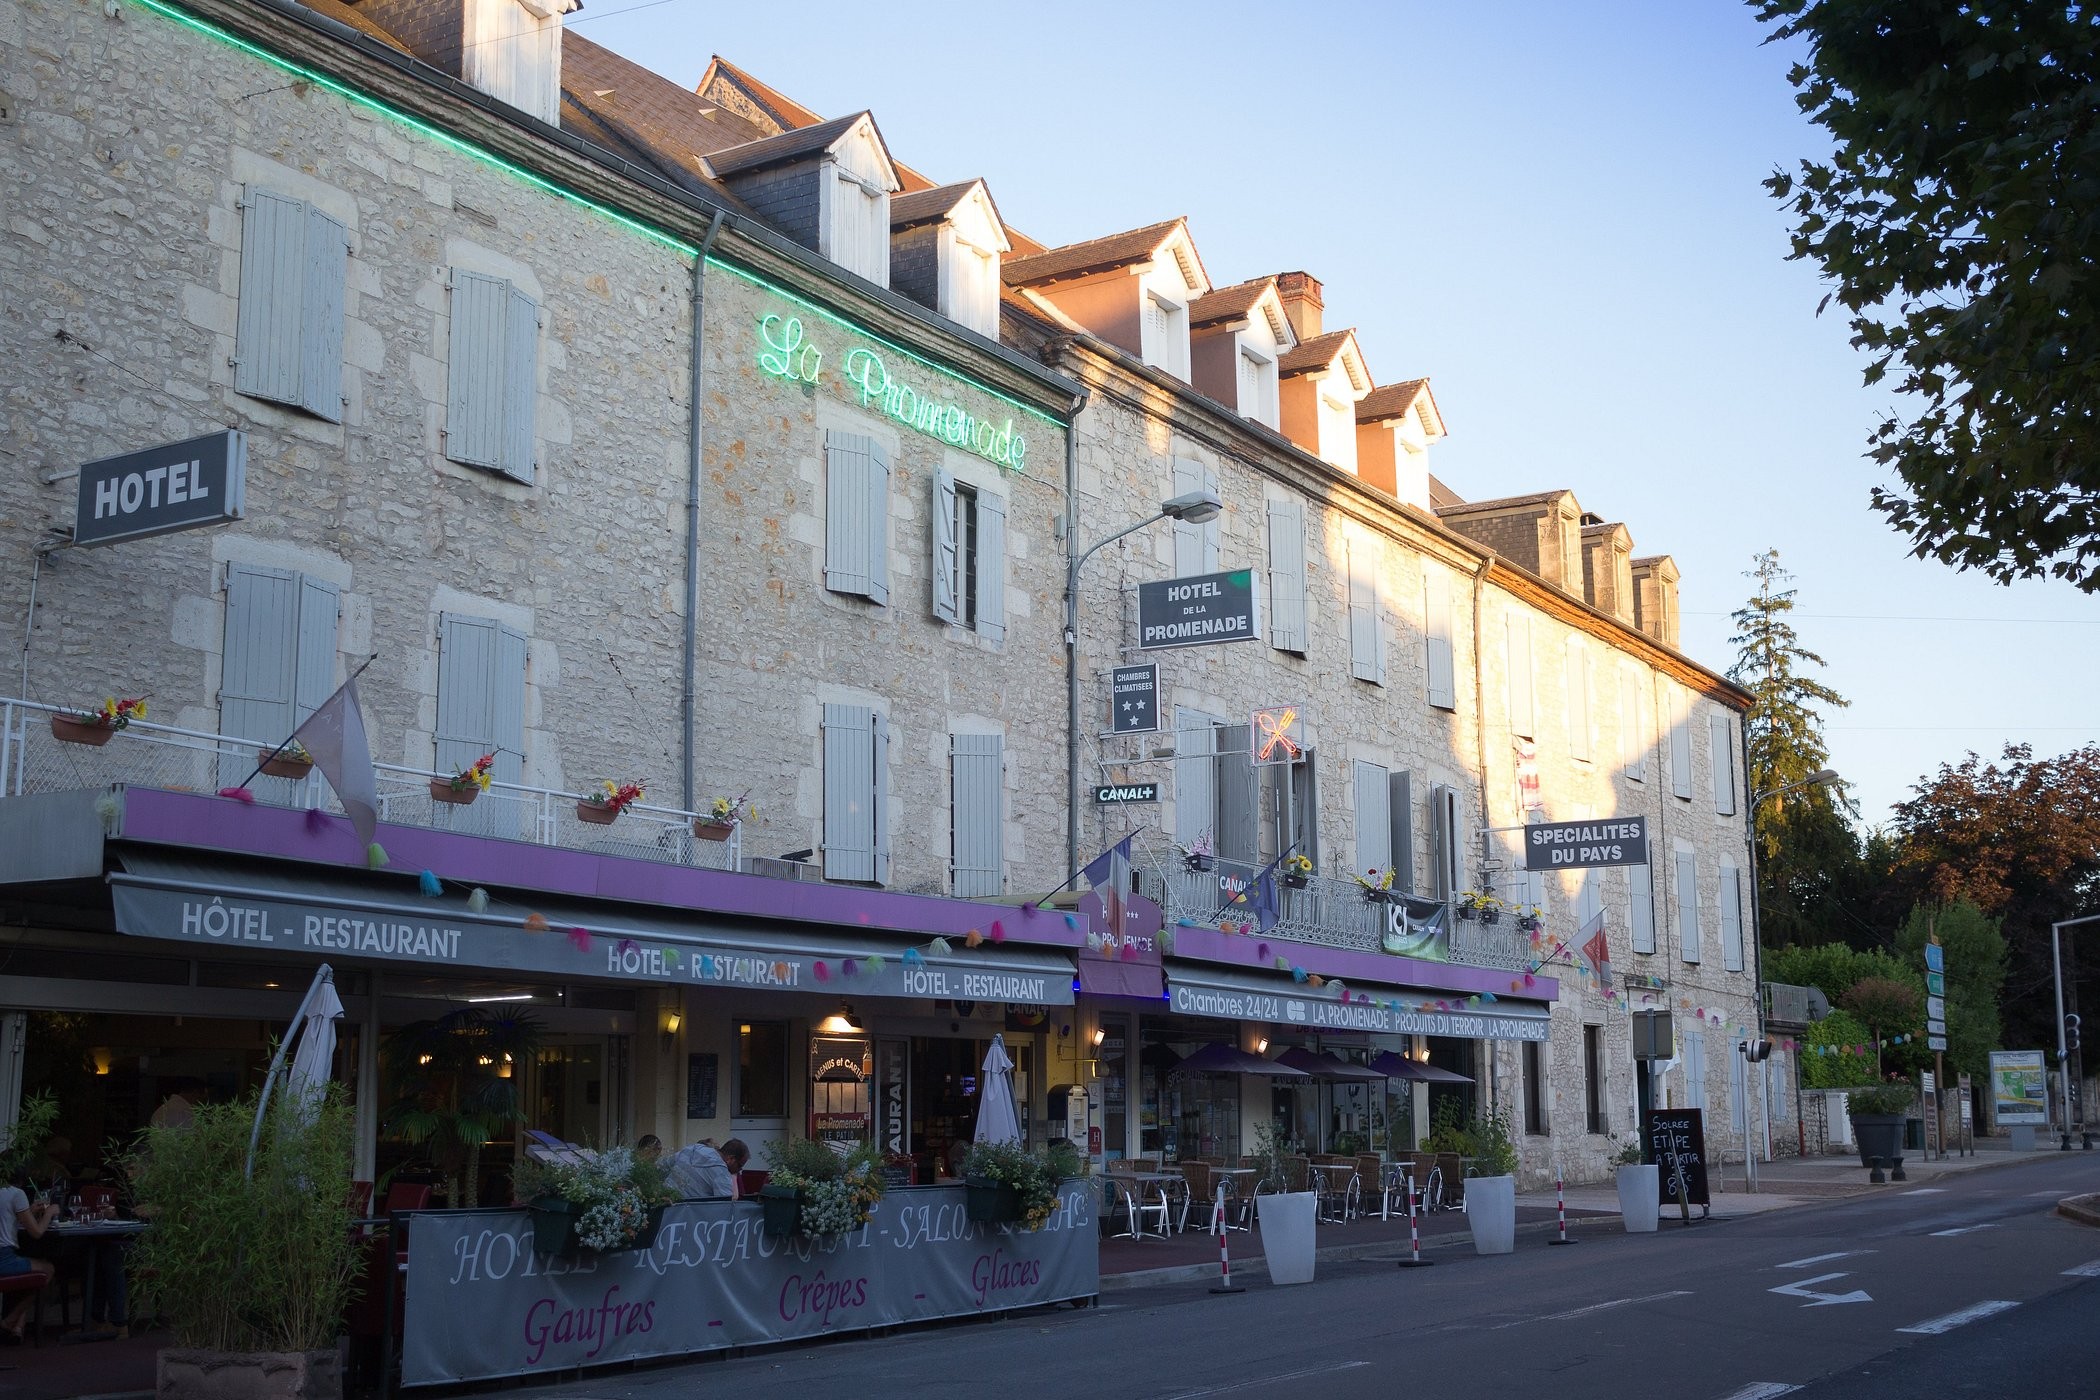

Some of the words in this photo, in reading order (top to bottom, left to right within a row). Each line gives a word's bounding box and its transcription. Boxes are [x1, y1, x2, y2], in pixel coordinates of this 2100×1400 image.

[761, 314, 822, 385] La
[847, 348, 1027, 471] Promenade
[94, 459, 209, 520] HOTEL
[1167, 582, 1222, 602] HOTEL
[1183, 606, 1194, 615] DE
[1196, 605, 1207, 614] LA
[1145, 615, 1248, 641] PROMENADE
[1114, 682, 1153, 693] CLIMATISEES
[1117, 671, 1150, 682] CHAMBRES
[1099, 786, 1154, 801] CANAL+
[1532, 823, 1641, 845] SPECIALITES
[1551, 848, 1575, 864] DU
[1580, 845, 1623, 862] PAYS
[182, 896, 274, 942] HÔTEL
[304, 915, 462, 959] RESTAURANT
[903, 965, 950, 995] HÔTEL
[964, 974, 1045, 1000] RESTAURANT
[1177, 987, 1243, 1015] Chambres
[1246, 996, 1278, 1020] 24/24
[1312, 1003, 1326, 1024] LA
[1328, 1006, 1388, 1030] PROMENADE
[1395, 1011, 1436, 1033] PRODUITS
[1437, 1016, 1449, 1034] DU
[1451, 1017, 1484, 1036] TERROIR
[1488, 1020, 1500, 1037] LA
[1500, 1021, 1545, 1039] PROMENADE
[814, 1058, 835, 1081] MENUS
[836, 1057, 843, 1067] et
[827, 1116, 865, 1129] Promenade
[1664, 1152, 1701, 1166] PRTIR
[524, 1285, 656, 1365] Gaufres
[779, 1269, 868, 1326] Crêpes
[972, 1249, 1040, 1307] Glaces
